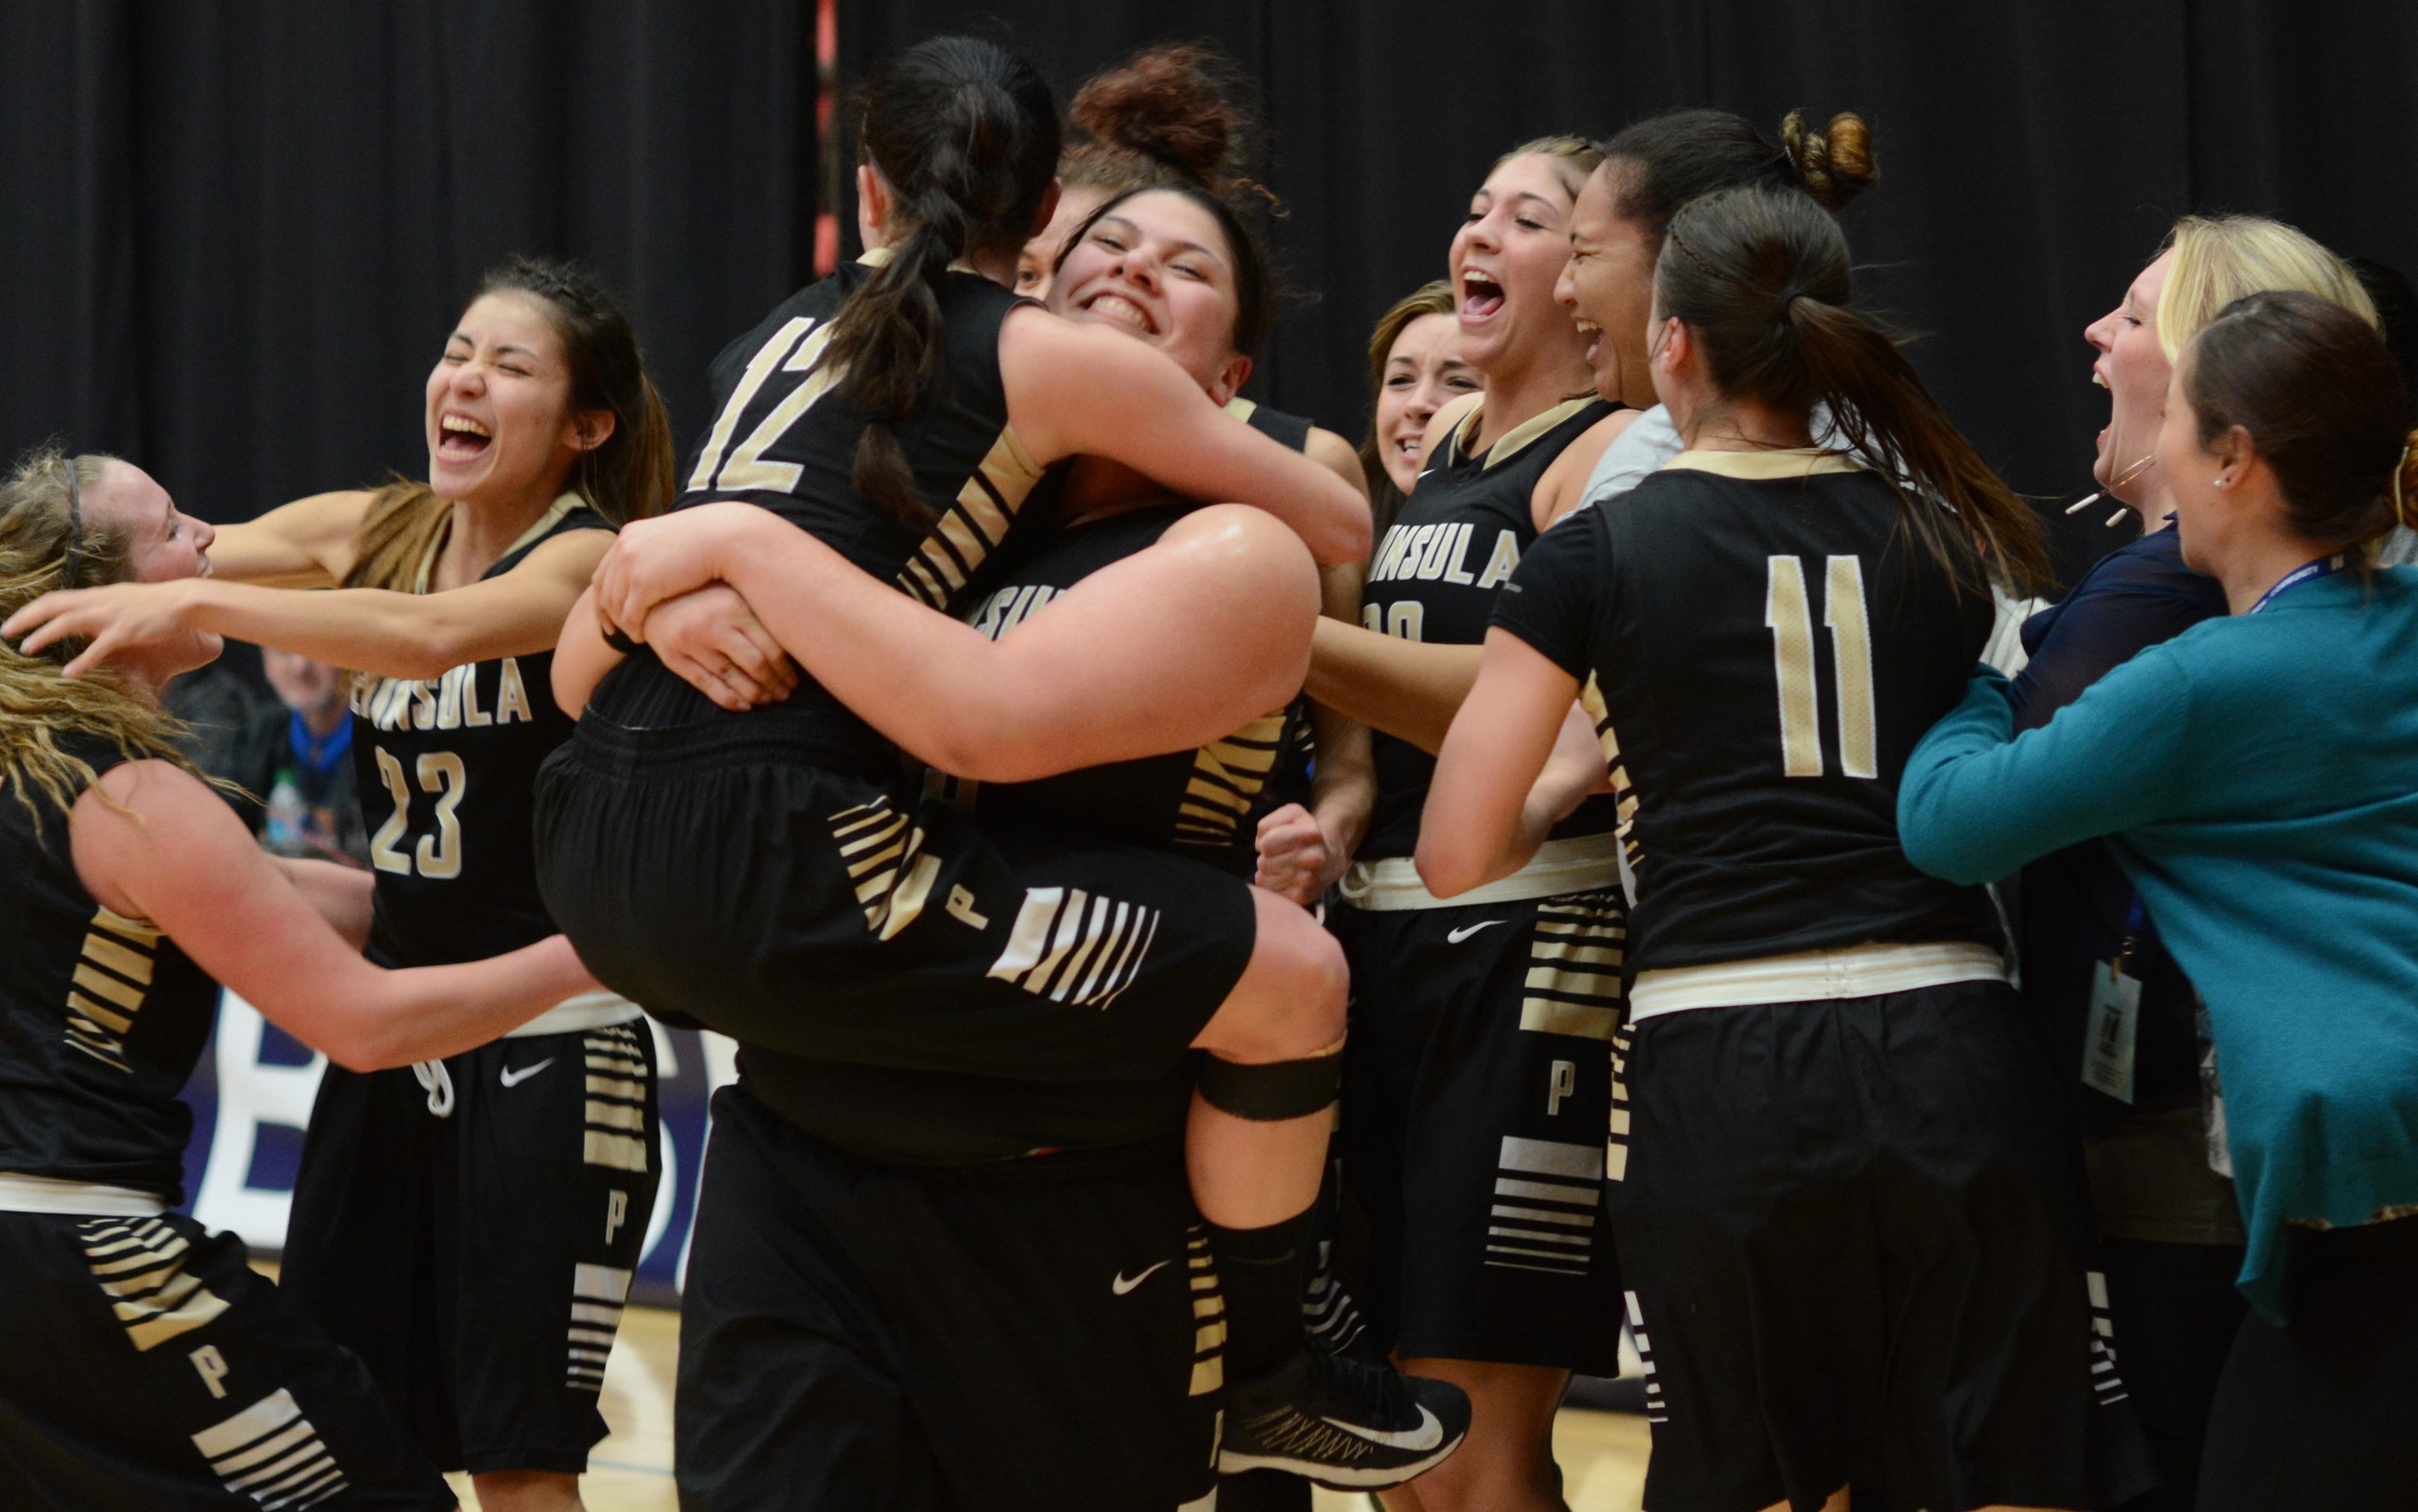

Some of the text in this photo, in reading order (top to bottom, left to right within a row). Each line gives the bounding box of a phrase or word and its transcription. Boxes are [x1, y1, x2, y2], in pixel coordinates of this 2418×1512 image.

[685, 315, 851, 494] 12
[1368, 522, 1521, 589] INSULA
[1765, 554, 1878, 778] 11
[370, 744, 466, 879] 23
[945, 883, 989, 930] P
[1547, 1060, 1575, 1115] P
[605, 1190, 628, 1246] P
[188, 1345, 229, 1399] P
